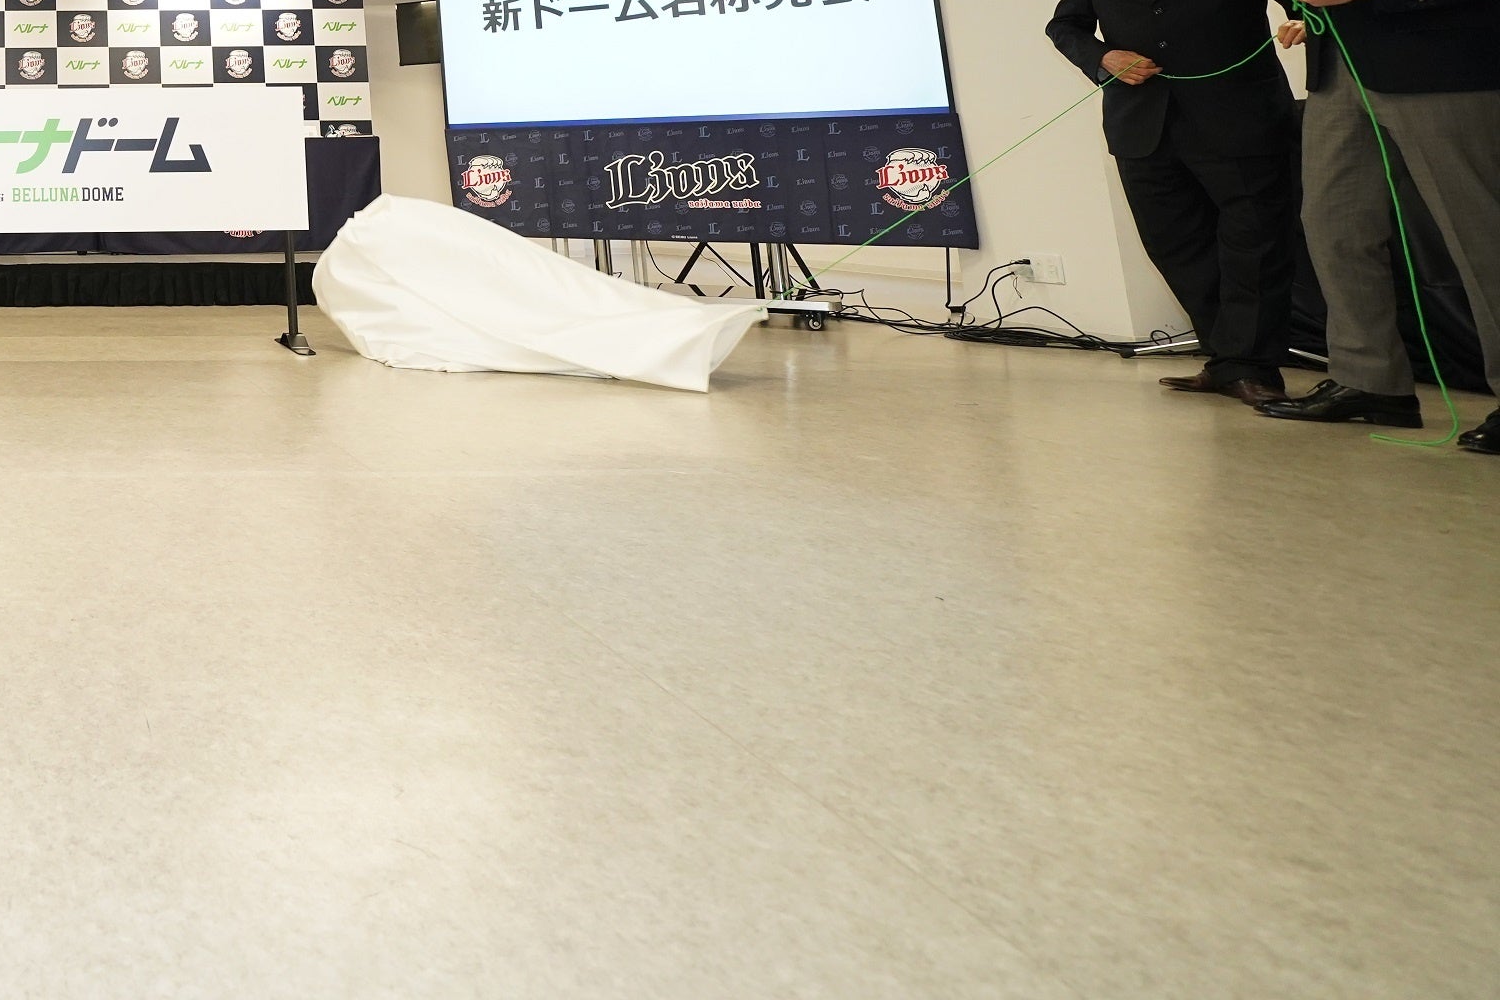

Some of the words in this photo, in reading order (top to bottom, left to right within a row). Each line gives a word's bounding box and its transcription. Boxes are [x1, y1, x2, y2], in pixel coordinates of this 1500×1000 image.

[14, 24, 49, 33] ベルーナ
[323, 22, 357, 31] ベルーナ
[66, 60, 100, 70] ベルーナ
[169, 60, 204, 69] ベルーナ
[273, 59, 307, 69] ベルーナ
[328, 96, 362, 106] ベルーナ
[461, 168, 512, 189] Lions
[604, 151, 760, 209] Lions
[875, 164, 949, 189] Lions
